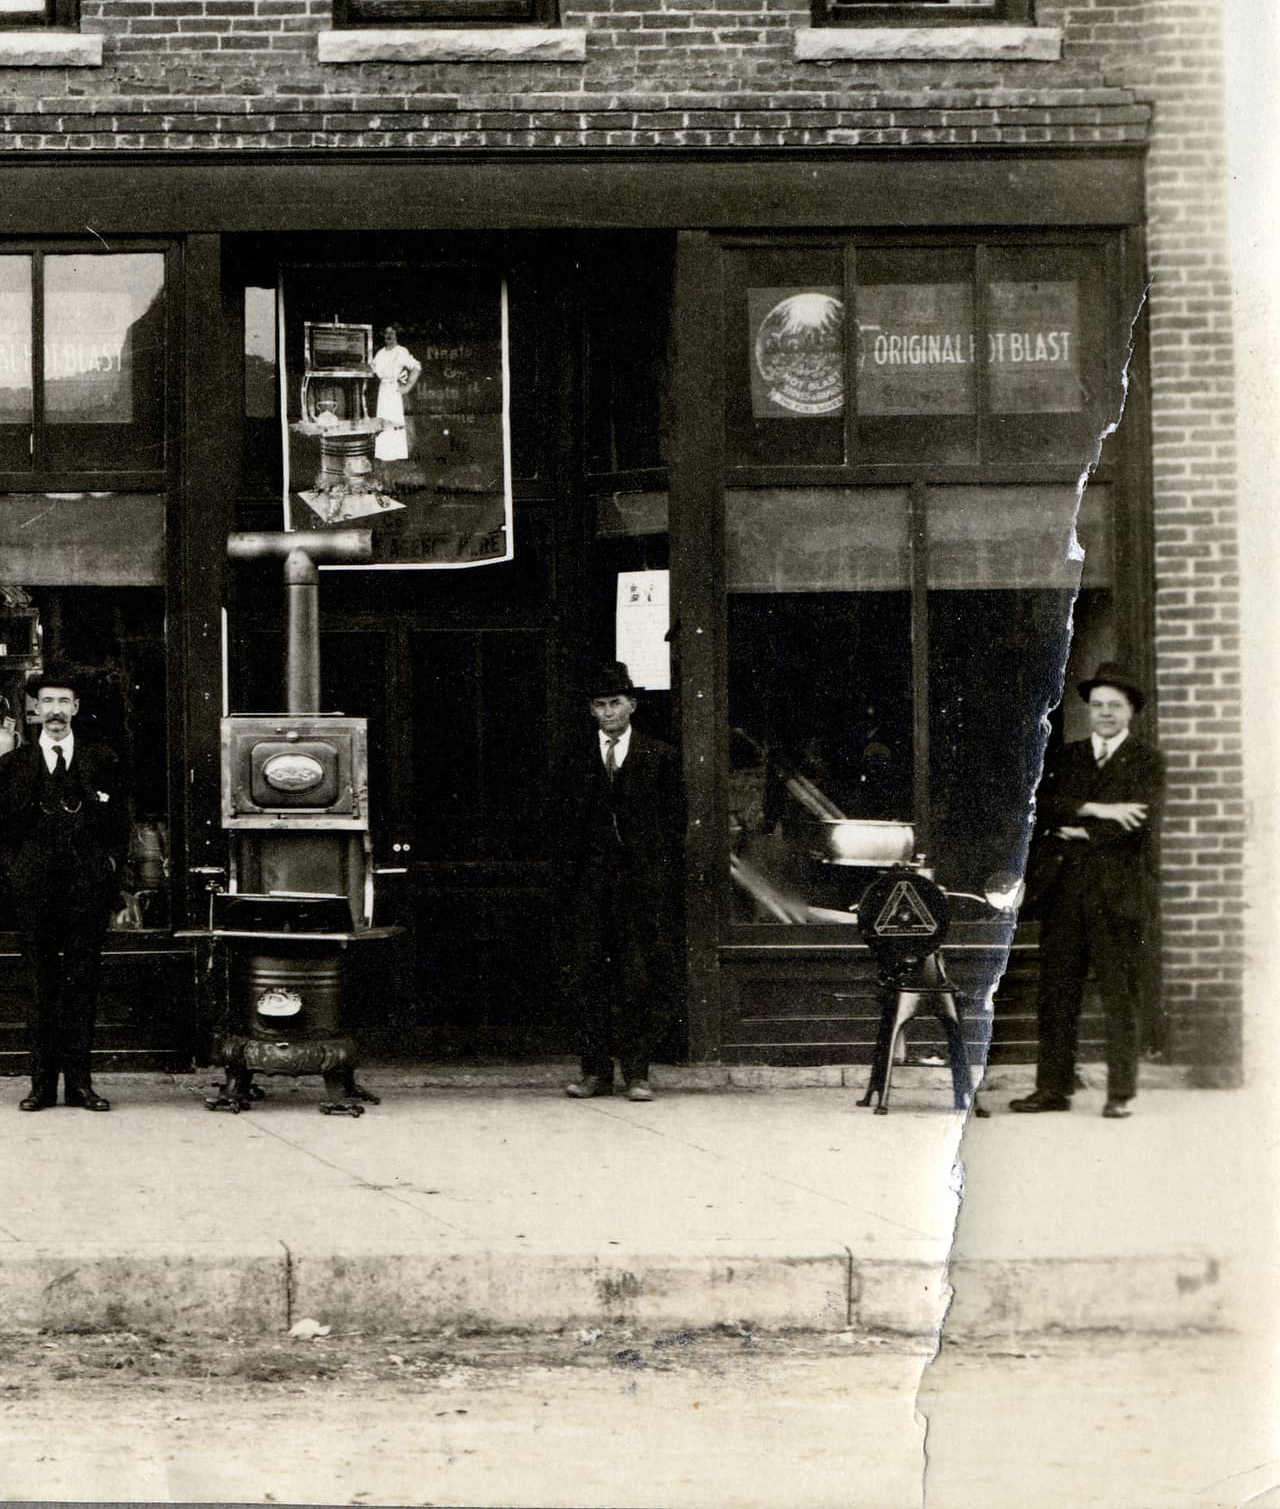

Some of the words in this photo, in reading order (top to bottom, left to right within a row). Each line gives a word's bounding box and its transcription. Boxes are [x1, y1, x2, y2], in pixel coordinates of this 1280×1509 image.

[65, 343, 123, 372] BLAST
[873, 334, 967, 365] ORIGINAL
[1010, 331, 1071, 363] BLAST
